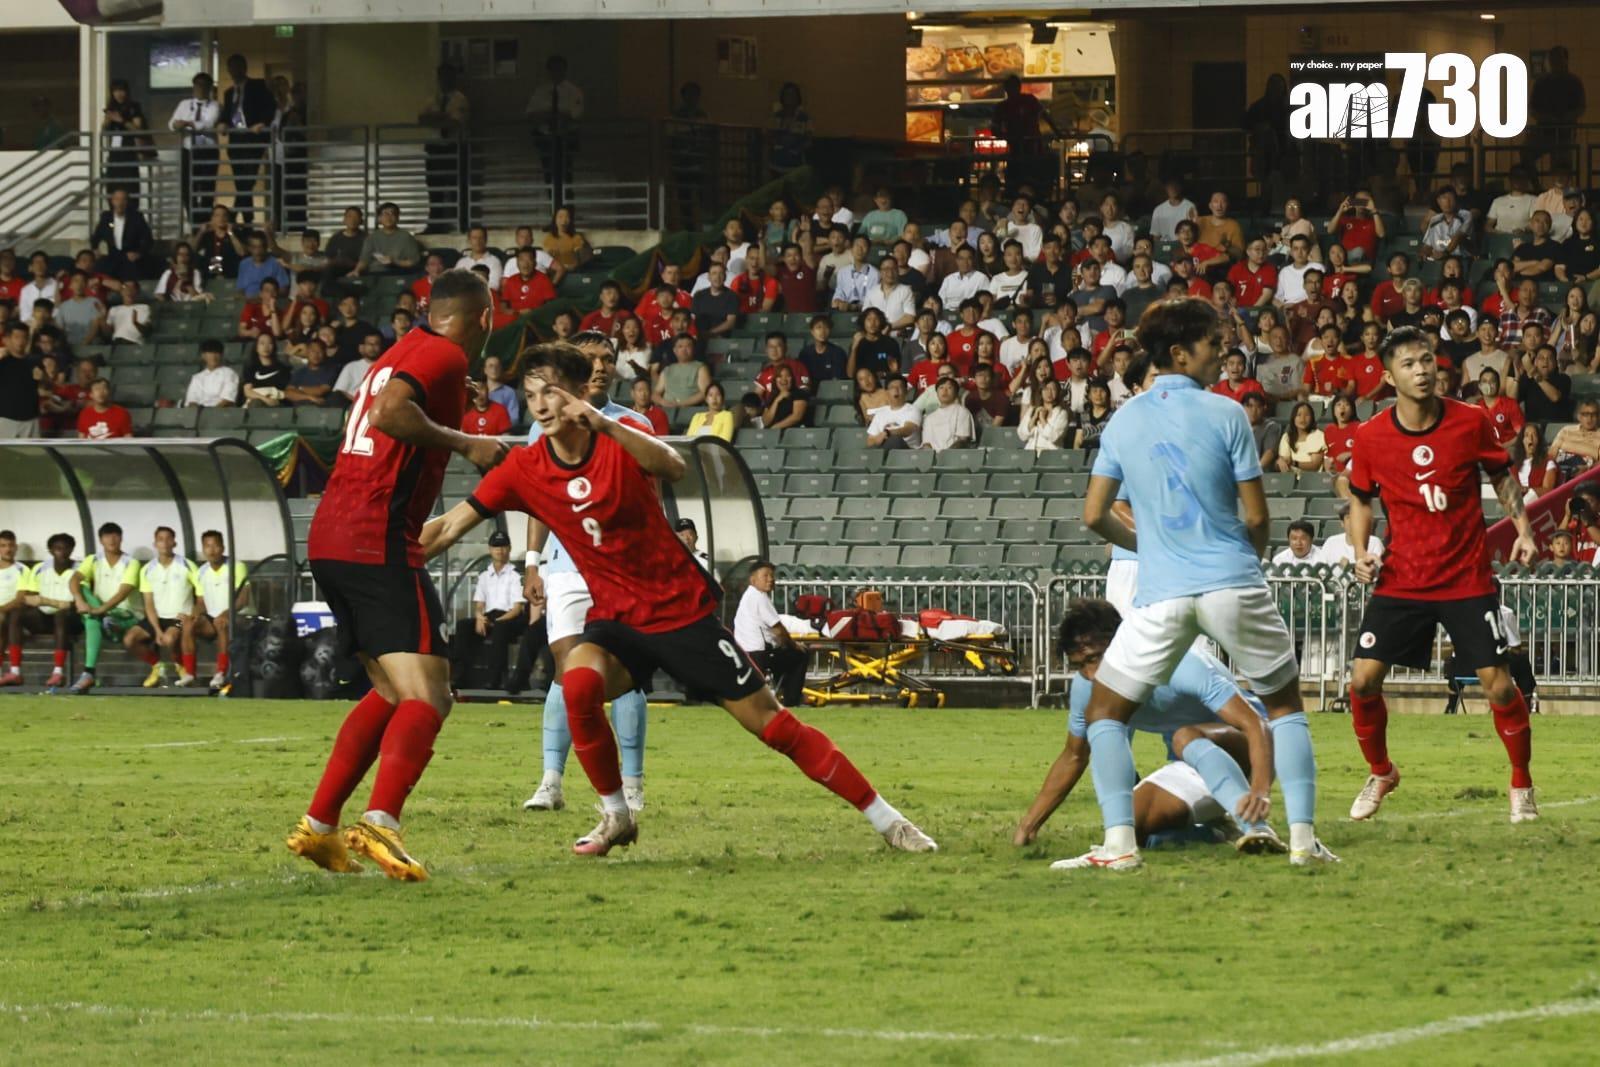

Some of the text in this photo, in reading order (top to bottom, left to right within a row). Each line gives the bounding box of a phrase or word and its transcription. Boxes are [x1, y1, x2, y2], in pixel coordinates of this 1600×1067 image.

[1240, 285, 1247, 297] 7
[1150, 442, 1201, 529] 3
[1419, 483, 1448, 512] 16
[582, 517, 602, 547] 9
[718, 639, 743, 669] 9
